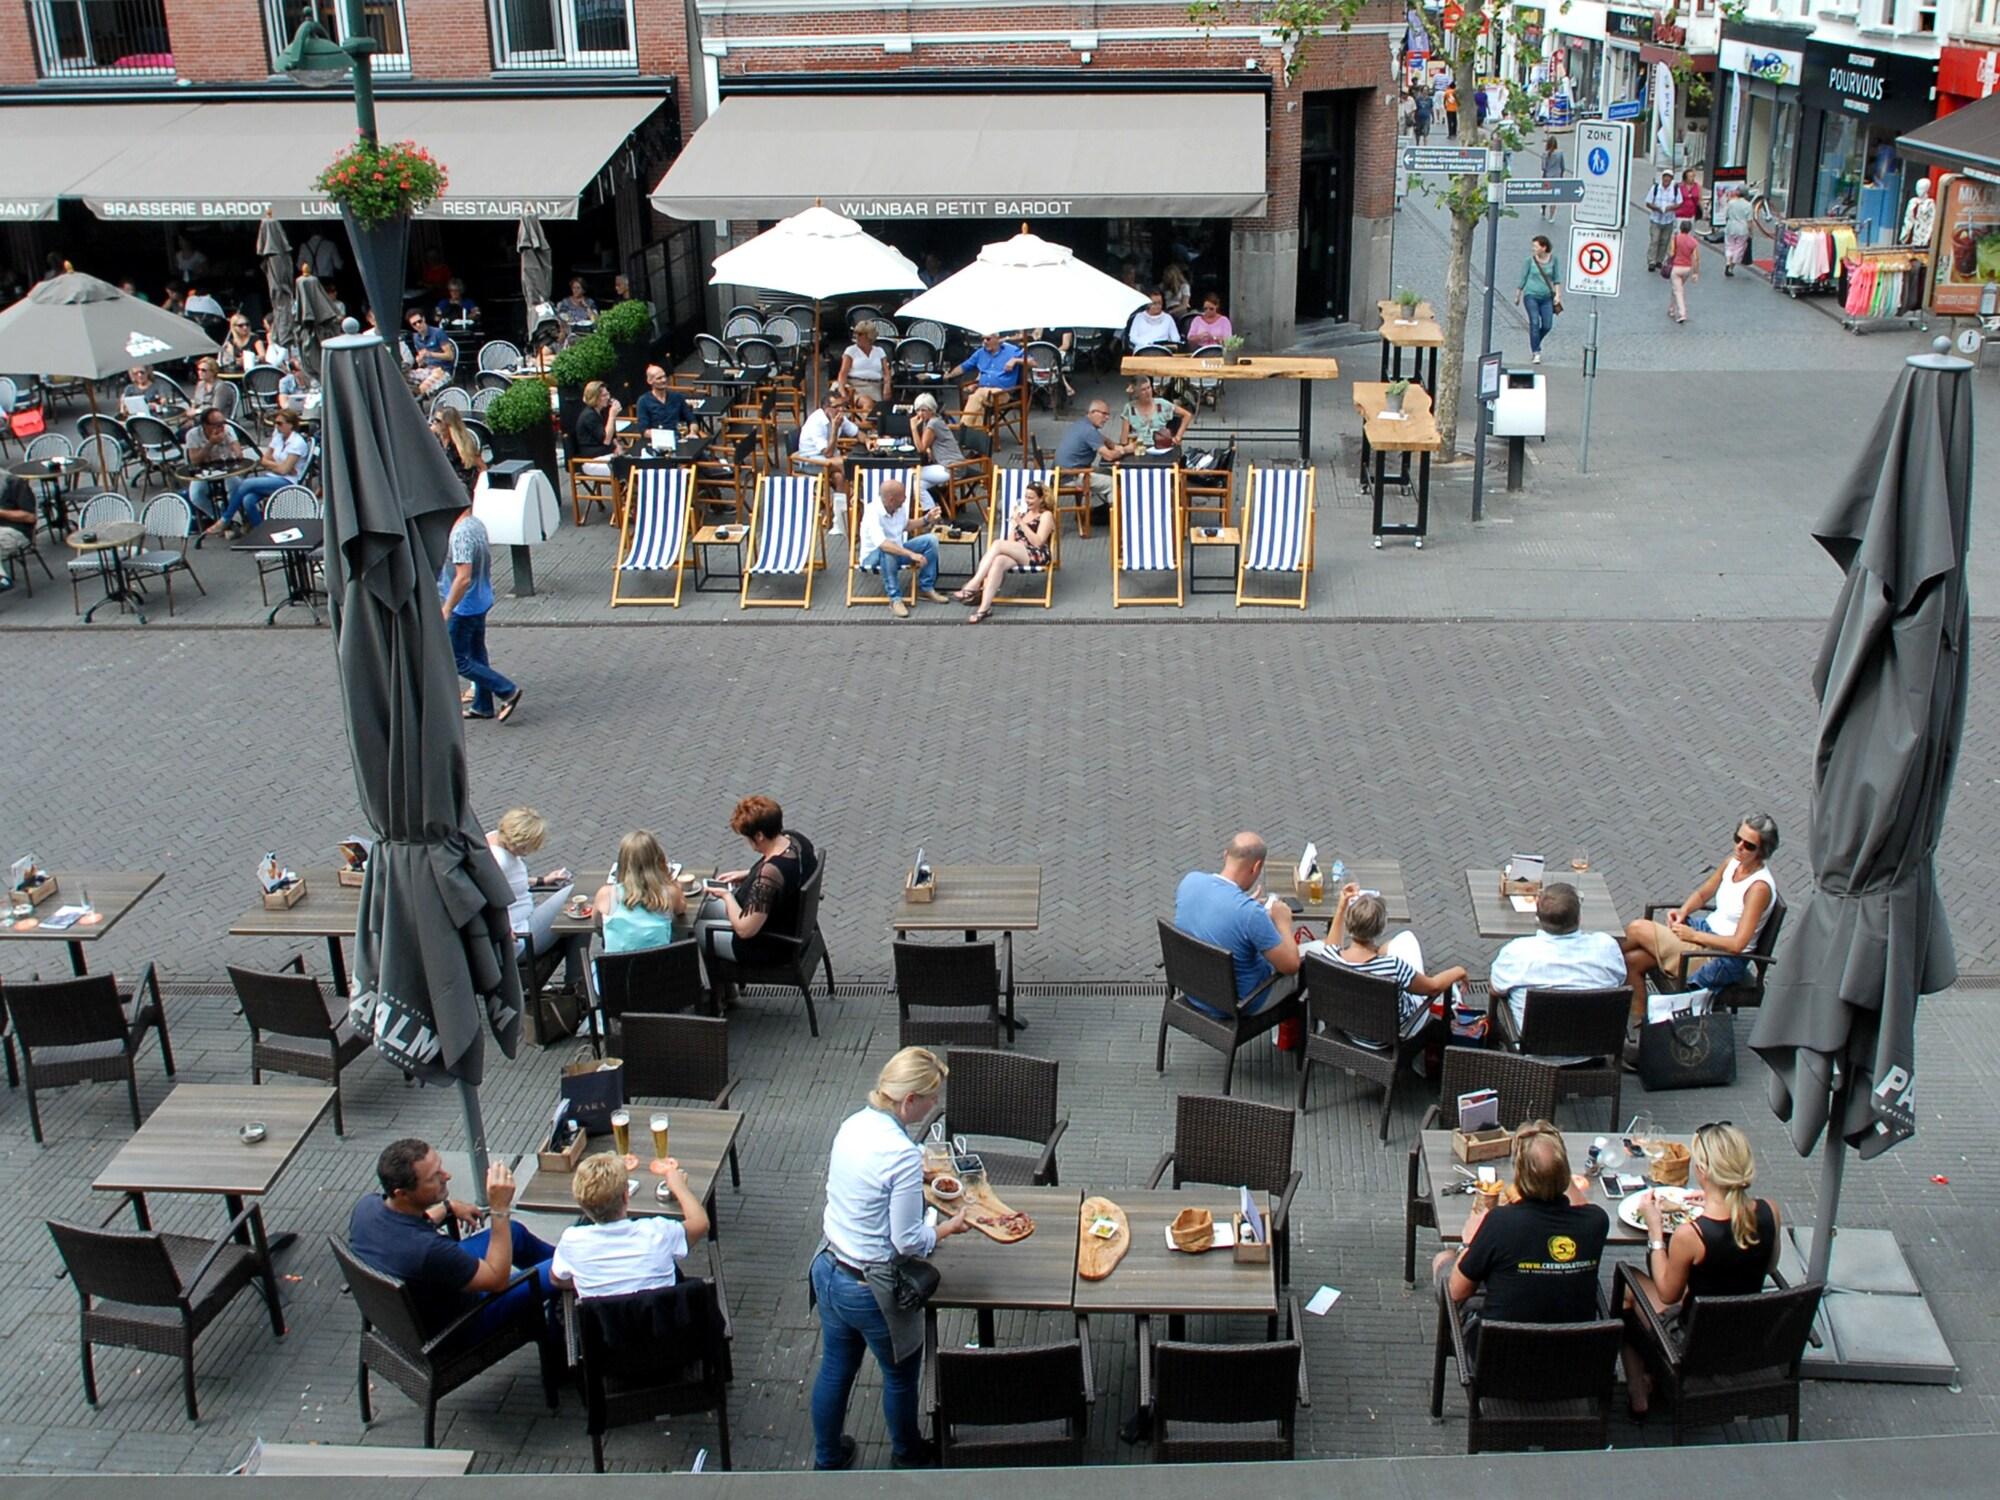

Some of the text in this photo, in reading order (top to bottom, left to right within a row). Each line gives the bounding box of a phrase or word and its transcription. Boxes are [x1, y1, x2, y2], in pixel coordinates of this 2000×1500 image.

[1829, 68, 1885, 101] POURVOUS
[1586, 130, 1613, 141] ZONE
[103, 202, 197, 217] BRASSERIE
[201, 201, 273, 216] BARDOT
[442, 201, 562, 216] RESTAURANT
[839, 201, 1073, 216] WIJNBAR PETIT BARDOT
